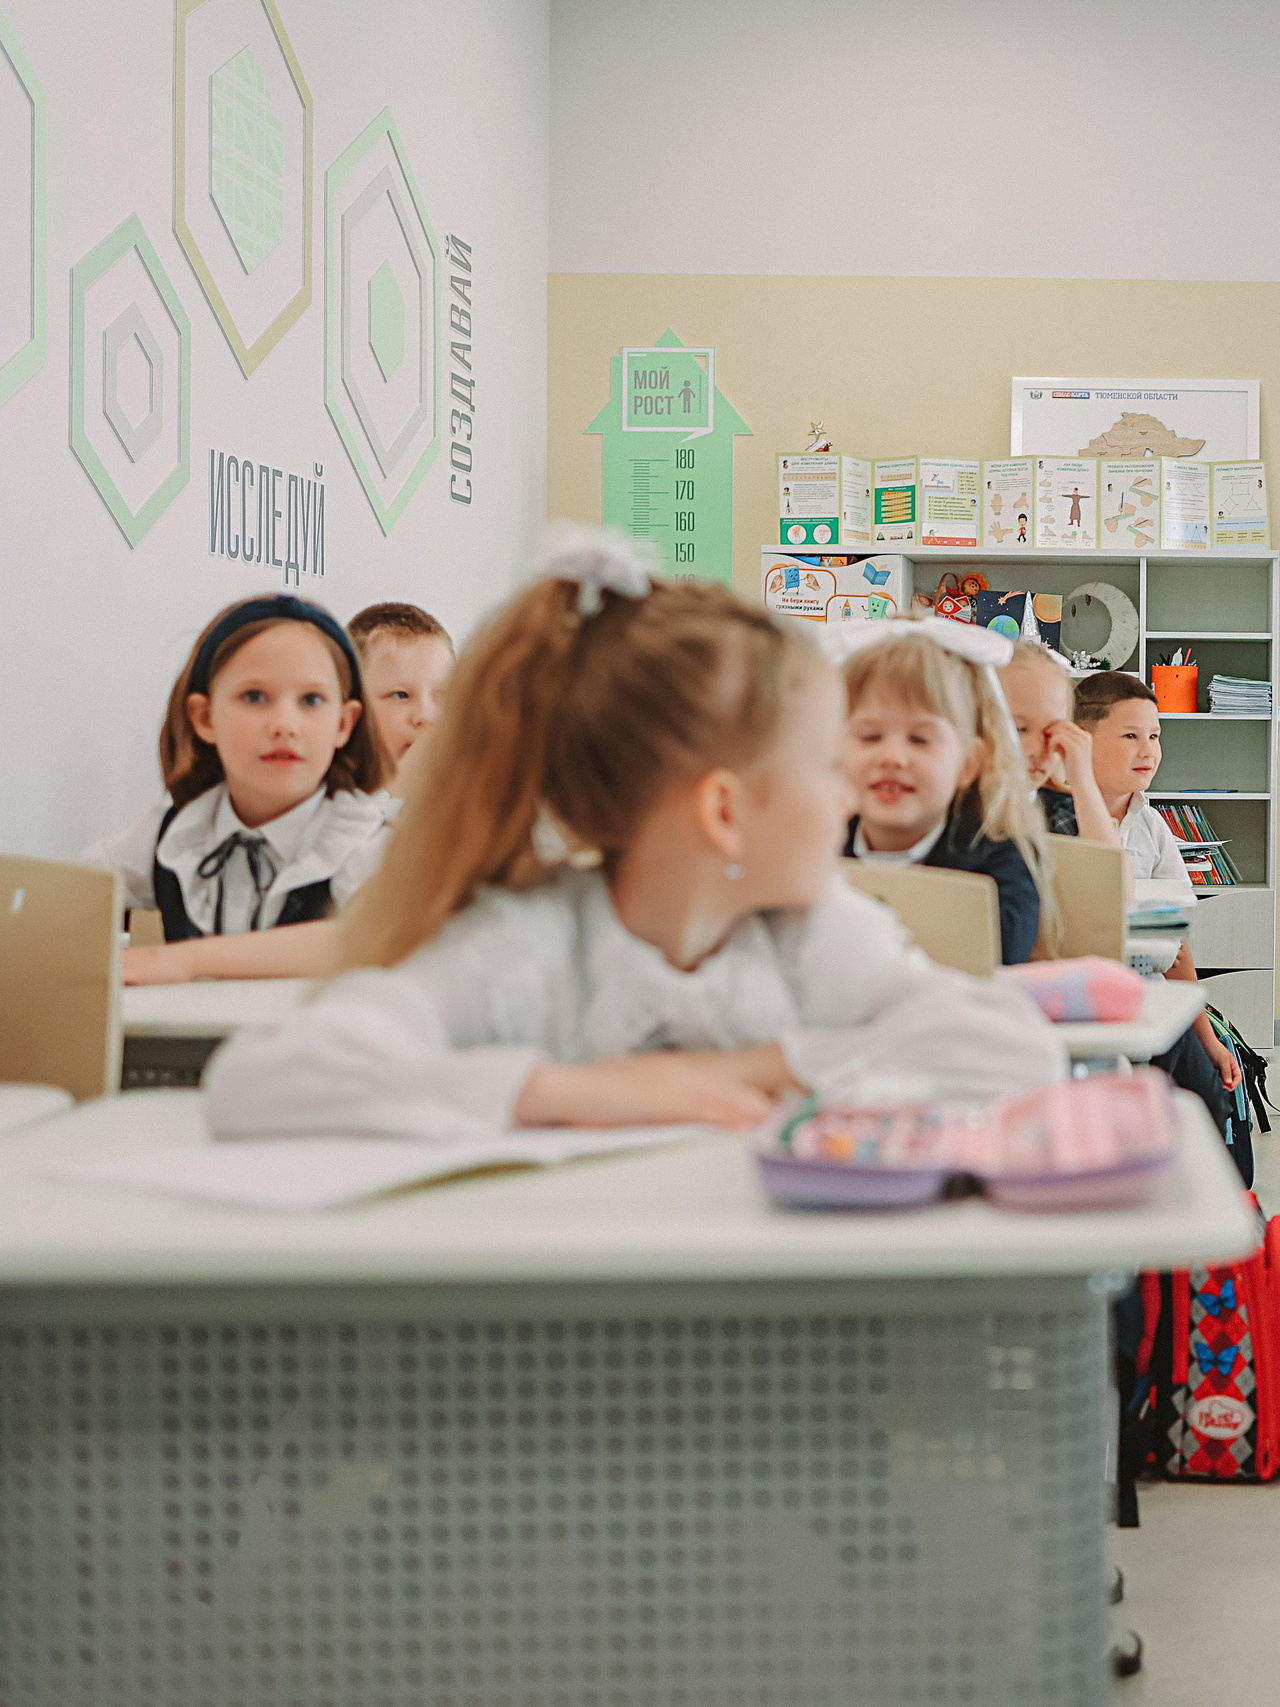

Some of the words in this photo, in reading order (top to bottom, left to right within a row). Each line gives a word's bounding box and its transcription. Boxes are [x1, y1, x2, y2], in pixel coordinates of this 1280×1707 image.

[446, 234, 475, 506] СОЗДАВАЙ
[633, 366, 670, 390] МОЙ
[633, 395, 674, 415] РОСТ
[1095, 391, 1142, 400] ТЮМЕНСКОЙ
[1143, 392, 1178, 400] ОБЛАСТИ
[674, 449, 695, 469] 180
[674, 480, 695, 500] 170
[209, 449, 325, 587] ИССЛЕДУЙ
[674, 511, 695, 531] 160
[674, 543, 695, 563] 150
